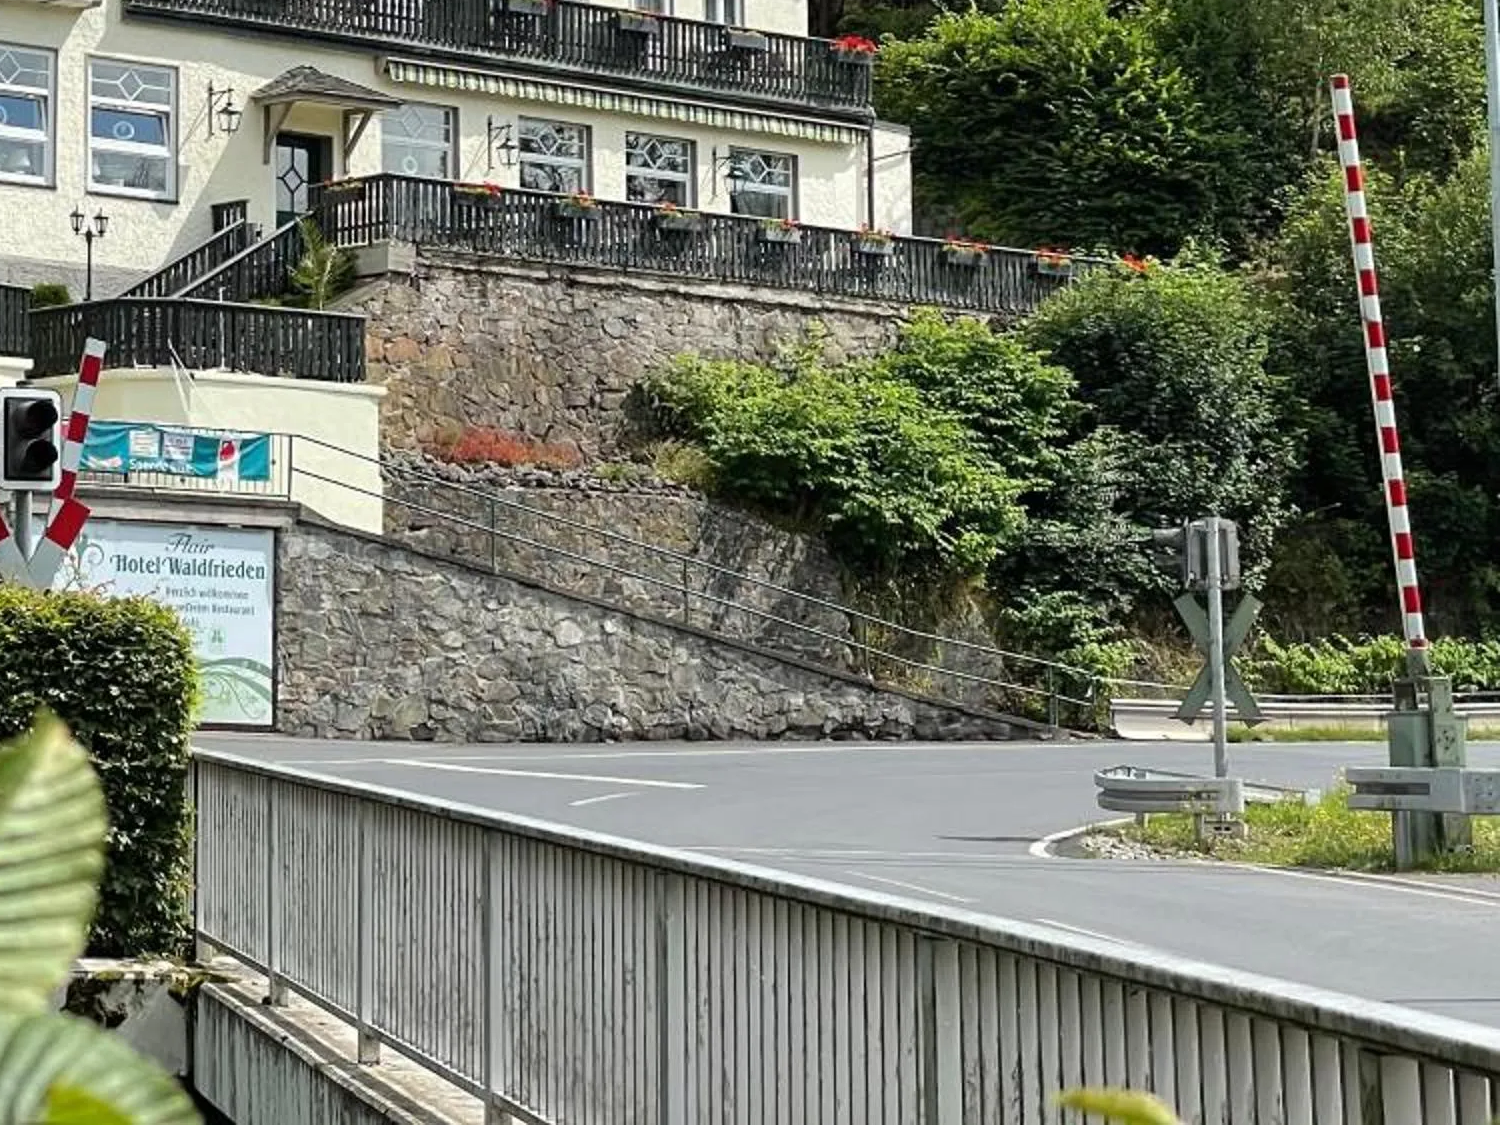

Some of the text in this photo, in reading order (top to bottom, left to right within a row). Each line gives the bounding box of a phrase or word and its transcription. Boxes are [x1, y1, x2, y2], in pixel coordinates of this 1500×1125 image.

[165, 532, 215, 554] Flair
[110, 554, 265, 580] Hotel Waldfrieden
